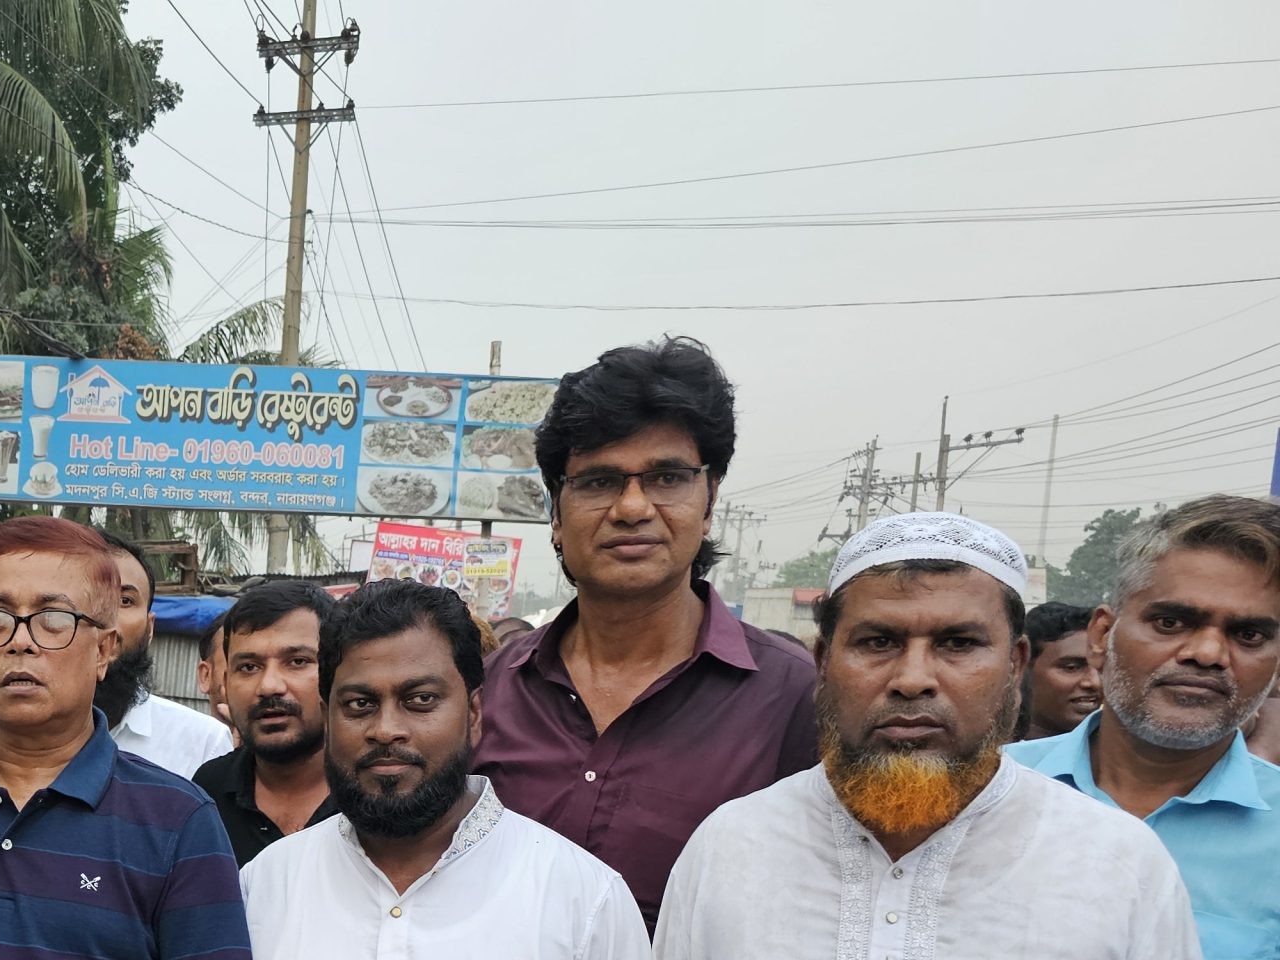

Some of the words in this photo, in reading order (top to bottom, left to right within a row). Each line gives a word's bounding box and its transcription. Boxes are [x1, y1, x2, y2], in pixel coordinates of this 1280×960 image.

[135, 382, 203, 421] আপন
[206, 366, 256, 429] বাড়ি
[70, 433, 113, 459] Hot
[118, 436, 179, 461] Line-
[182, 438, 345, 469] 01960-060081
[64, 463, 89, 477] হোম
[92, 461, 142, 479] ডেলিভারী
[145, 466, 167, 480] করা
[169, 467, 186, 481] হয়
[189, 469, 213, 482] এবং
[216, 467, 247, 483] অর্ডার
[250, 471, 293, 486] সরবরাহ
[296, 473, 319, 486] করা
[64, 483, 108, 500] মদনপুর
[378, 532, 418, 550] আল্লাহর
[420, 537, 441, 554] দান
